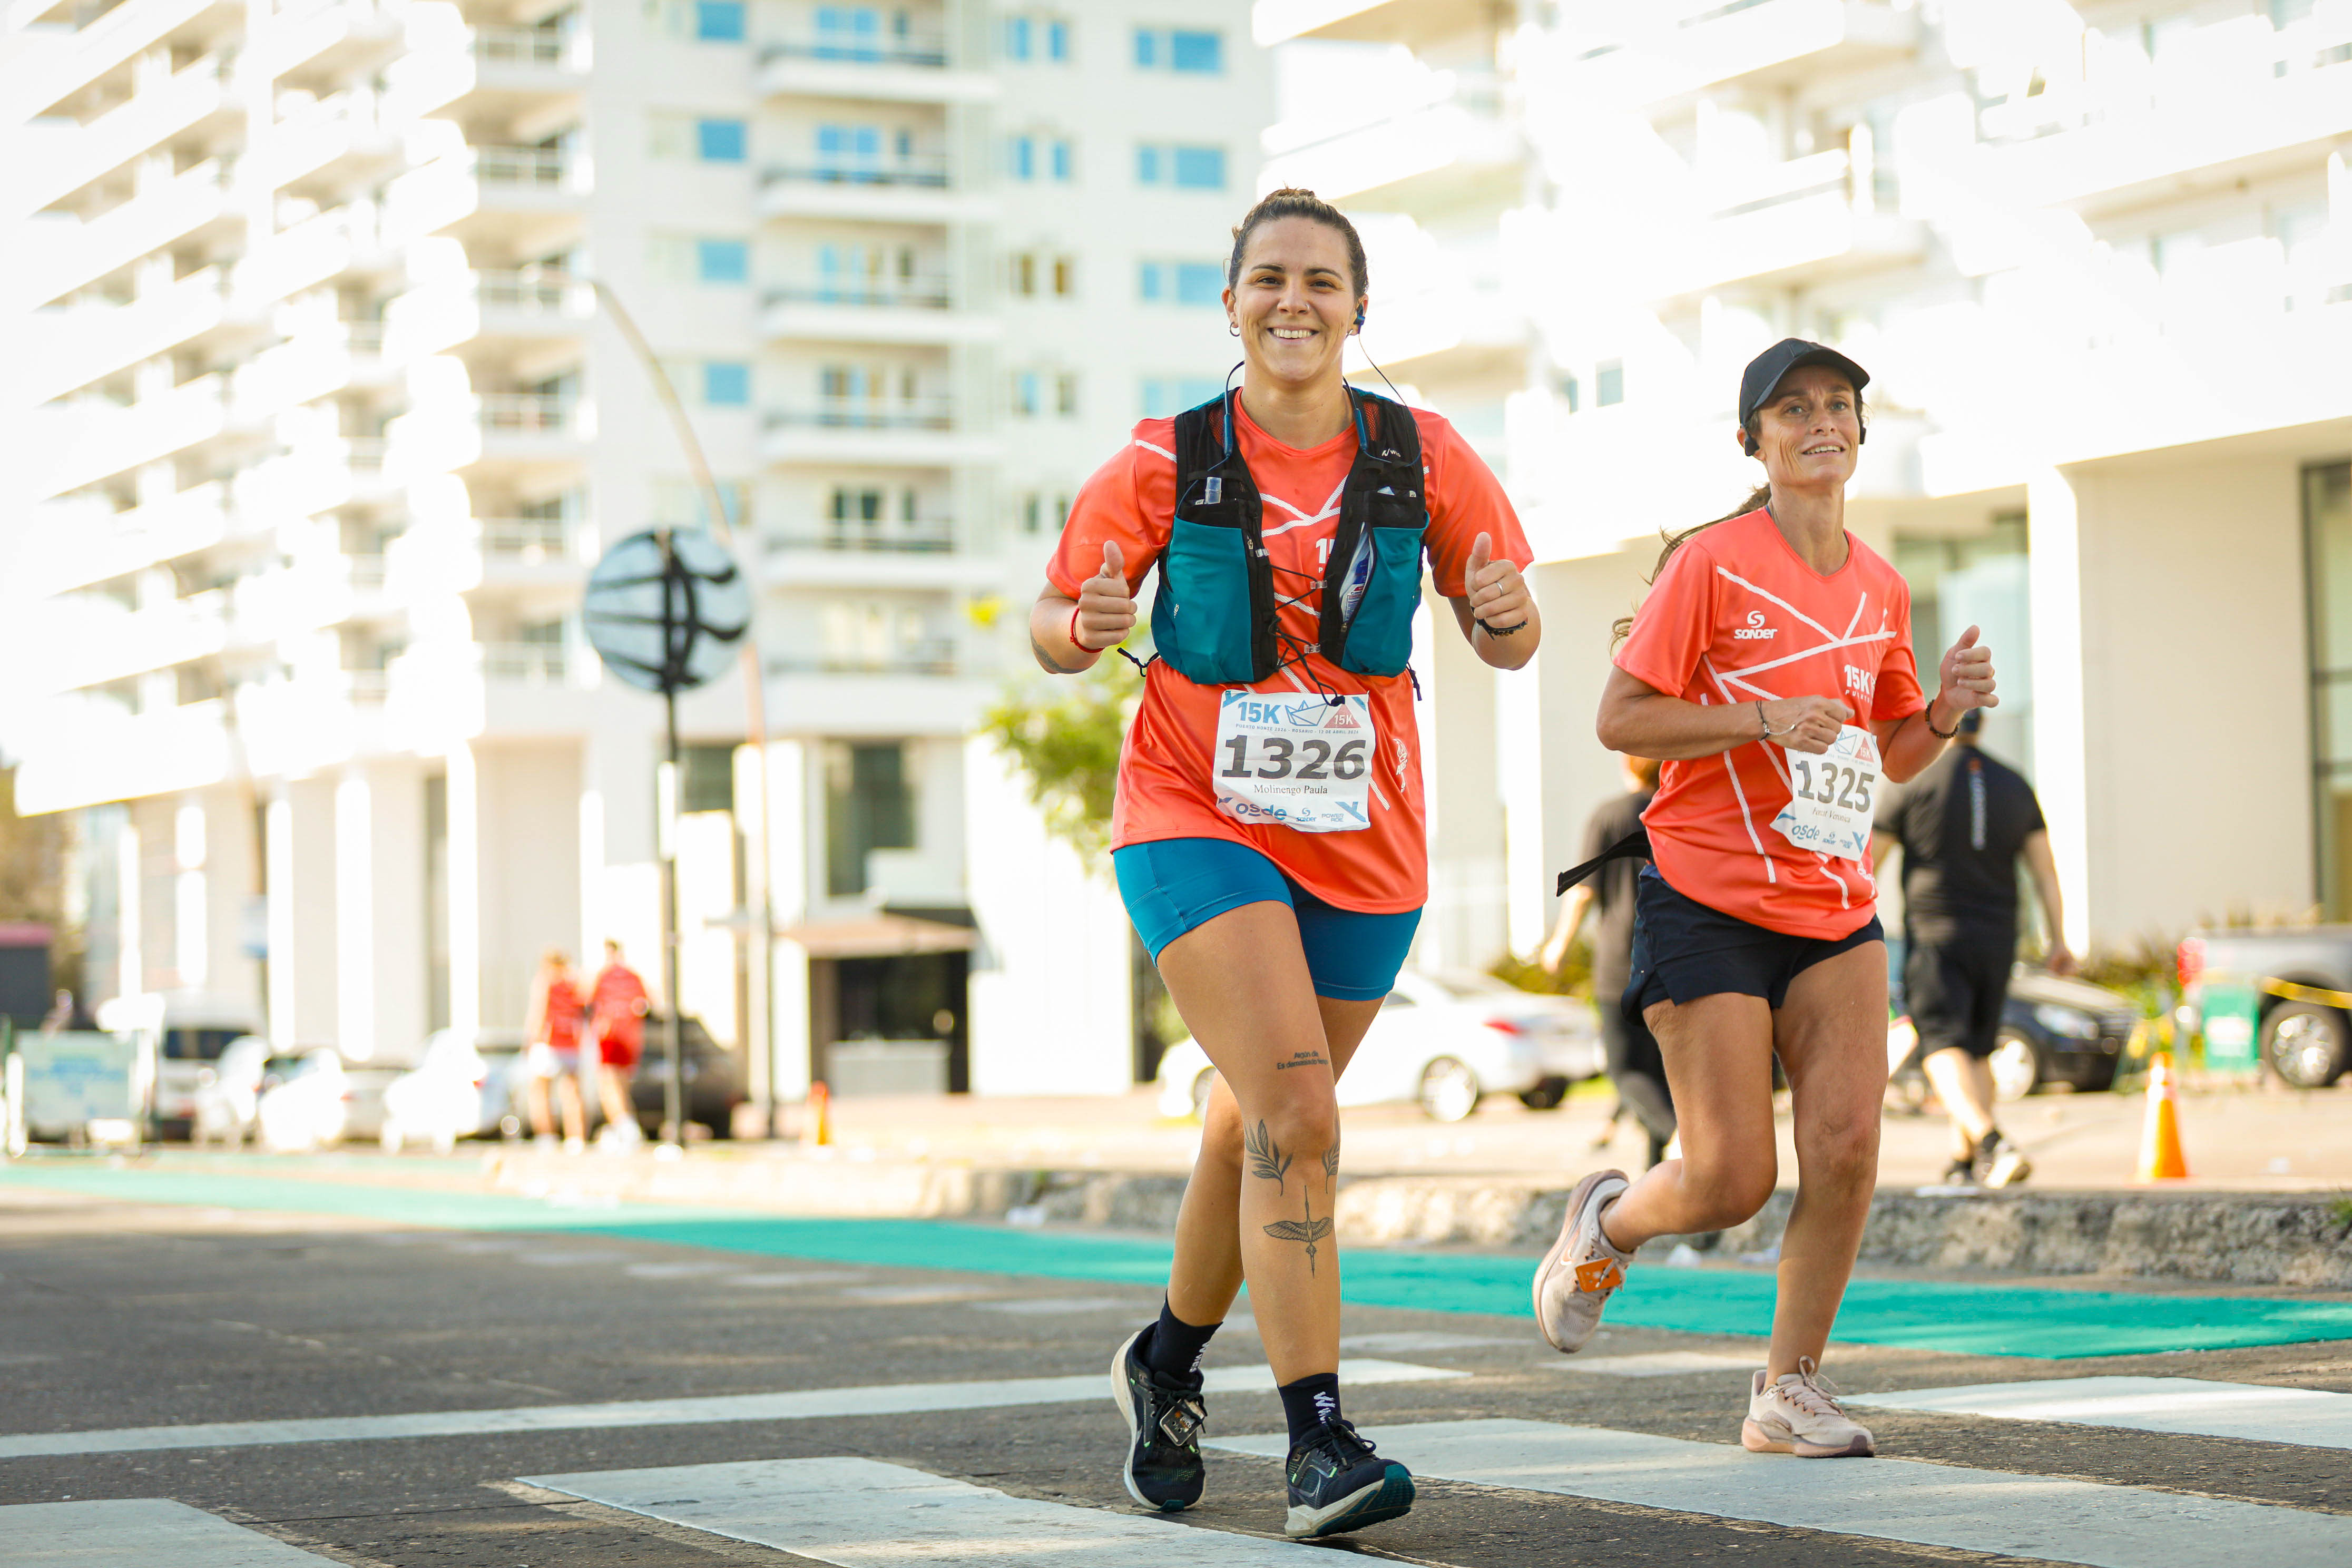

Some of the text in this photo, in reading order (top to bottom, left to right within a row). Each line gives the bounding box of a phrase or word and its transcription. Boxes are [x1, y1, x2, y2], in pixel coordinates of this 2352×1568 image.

[1844, 664, 1871, 695] 15K
[1238, 701, 1282, 724] 15K
[1334, 714, 1354, 726] 15K
[1222, 734, 1366, 780] 1326
[1860, 747, 1871, 759] 15K
[1253, 785, 1328, 796] Molinengo Paula
[1795, 760, 1875, 812] 1325
[1236, 803, 1287, 821] osde
[1829, 810, 1851, 822] Veronica
[1791, 825, 1820, 840] osde
